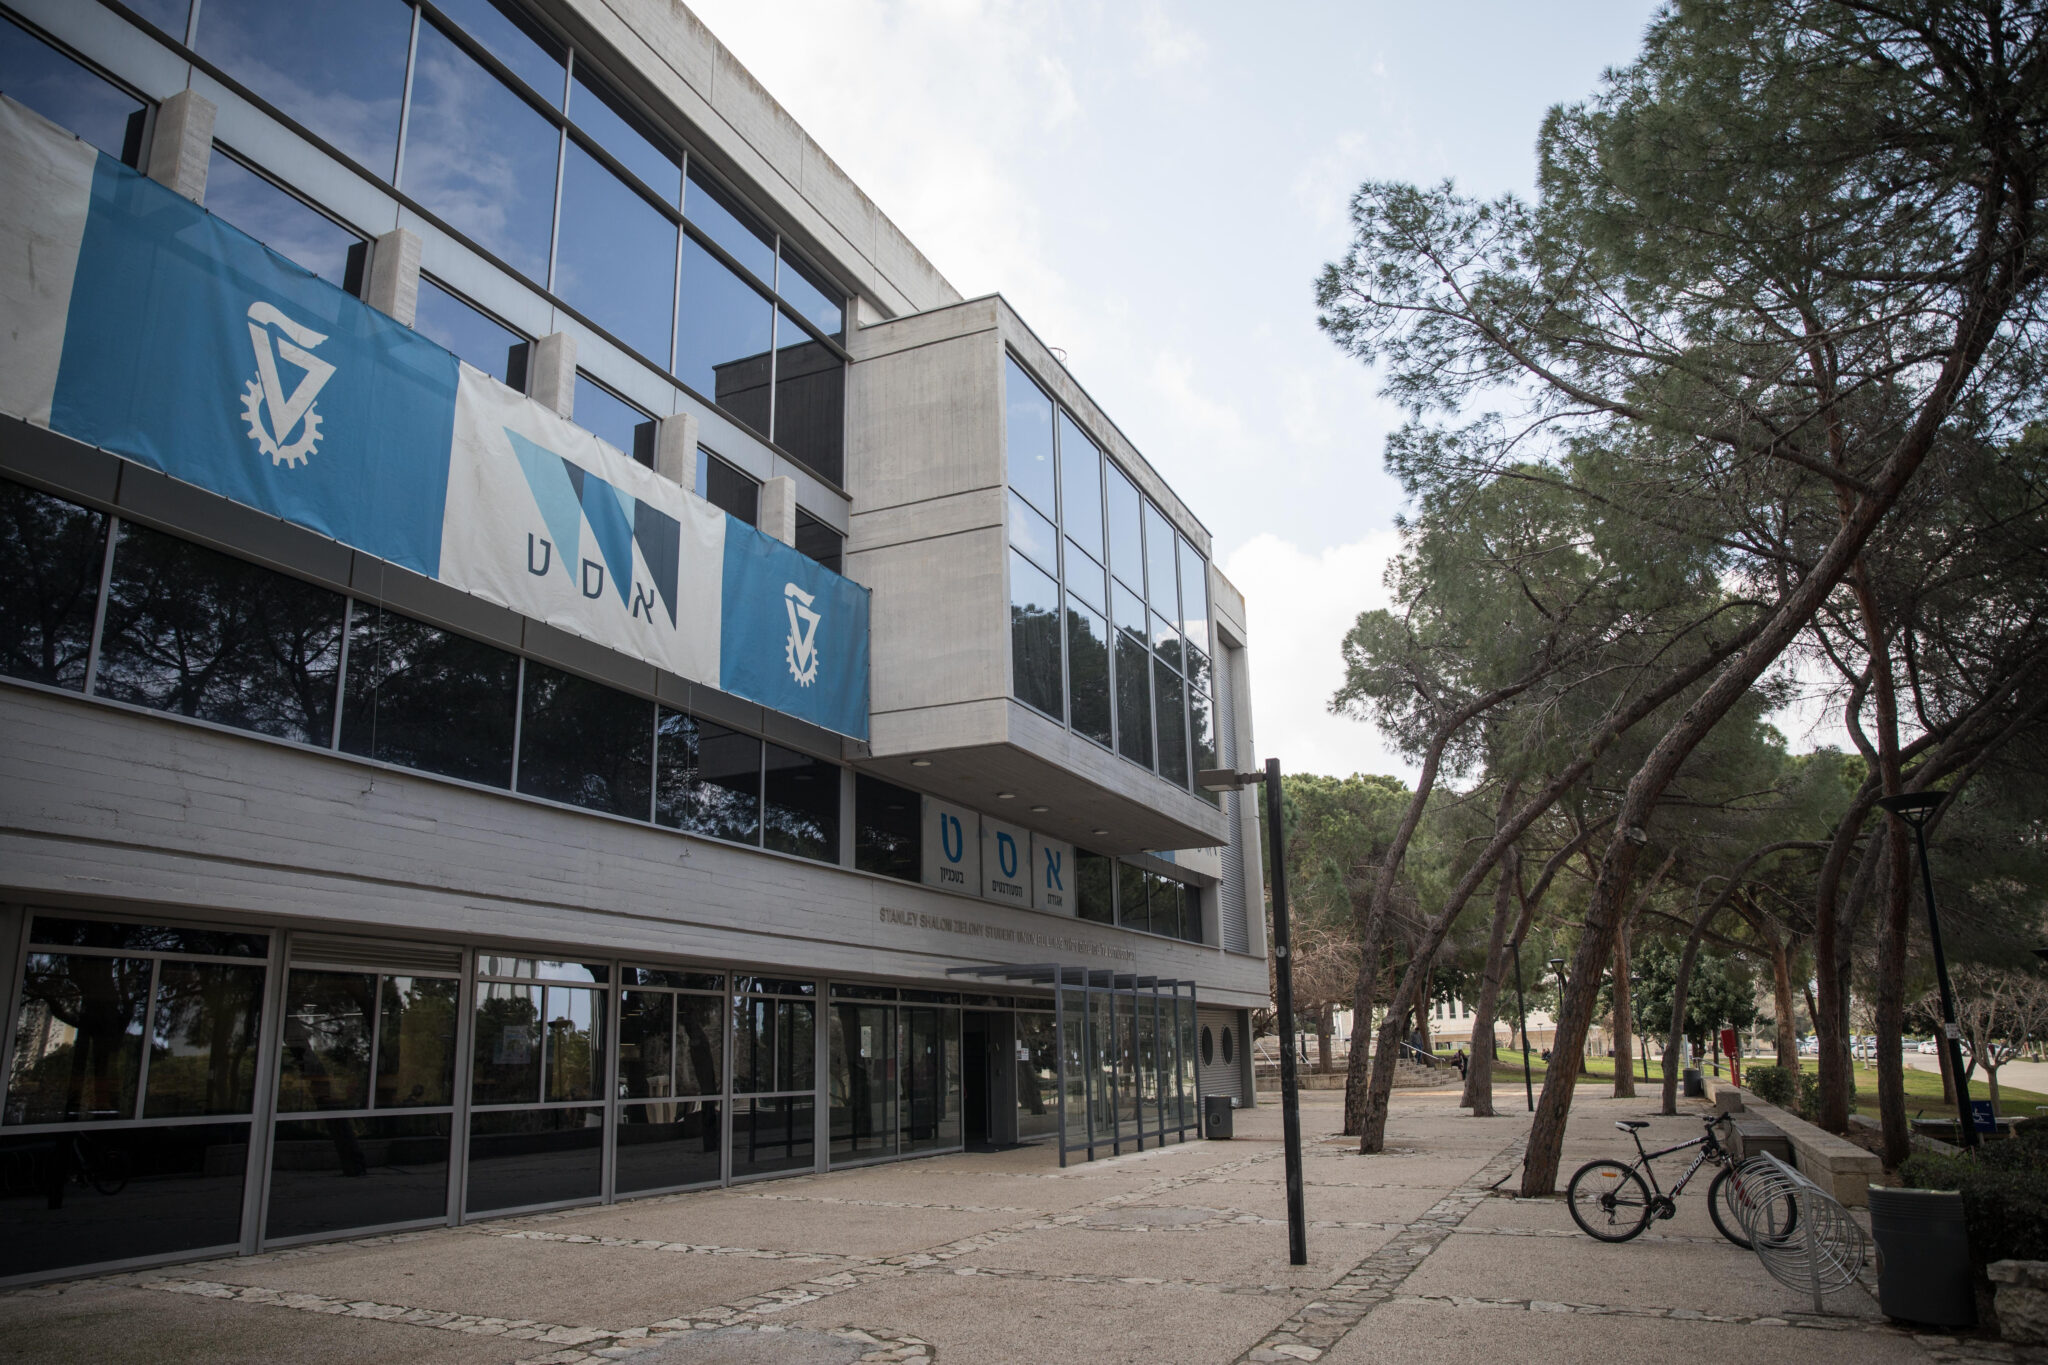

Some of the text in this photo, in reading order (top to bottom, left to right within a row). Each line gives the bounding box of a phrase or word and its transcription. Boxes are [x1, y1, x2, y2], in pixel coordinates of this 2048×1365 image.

[939, 866, 1063, 907] אגודת הסטודנטים בטכניון
[880, 907, 918, 927] STANLEY
[920, 913, 952, 932] SHALOM
[985, 925, 1014, 943] STUDENT
[1675, 1150, 1706, 1189] MERIDA
